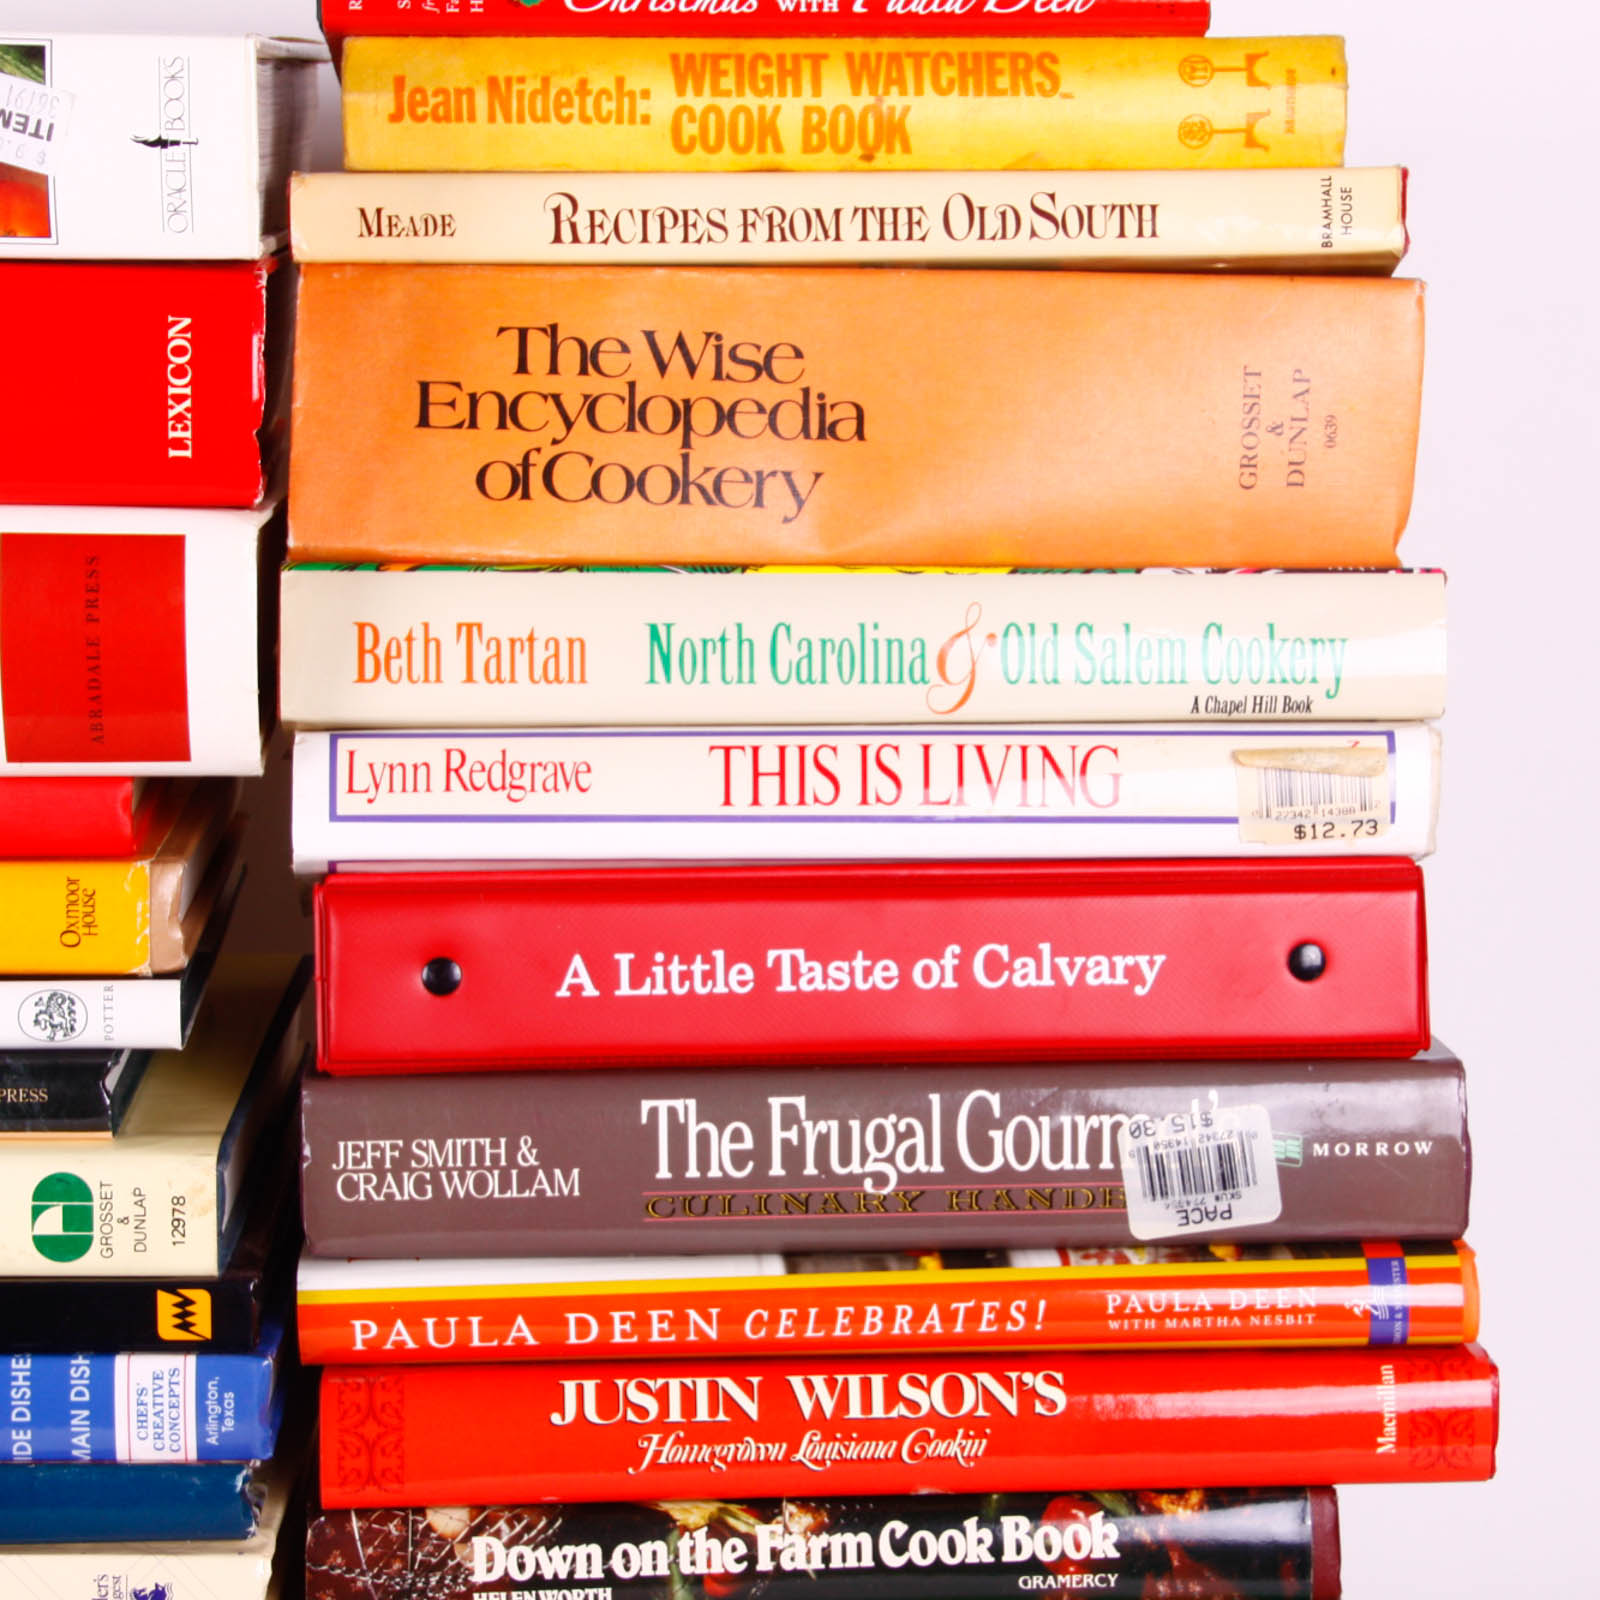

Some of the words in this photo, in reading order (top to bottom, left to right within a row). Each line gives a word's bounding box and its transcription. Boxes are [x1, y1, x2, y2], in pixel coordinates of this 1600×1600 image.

[164, 56, 186, 132] BOOKS
[387, 75, 475, 124] Jean
[487, 75, 652, 126] Nidetch:
[670, 52, 831, 98] WEIGHT
[845, 51, 1062, 98] WATCHERS
[671, 104, 785, 155] COOK
[800, 104, 912, 156] BOOK
[166, 152, 190, 234] ORACLE
[357, 207, 457, 239] MEADE
[543, 192, 728, 246] RECIPES
[738, 205, 842, 243] FROM
[851, 205, 931, 243] THE
[942, 192, 1022, 242] OLD
[1029, 191, 1161, 241] SOUTH
[1321, 174, 1334, 249] BRAMHALL
[1341, 186, 1353, 237] HOUSE
[497, 323, 632, 378] The
[641, 330, 806, 384] Wise
[167, 315, 193, 459] LEXICON
[415, 380, 867, 450] Encyclopedia
[1238, 365, 1262, 491] GROSSET
[1266, 421, 1284, 437] &
[1286, 369, 1311, 487] DUNLAP
[1324, 415, 1338, 449] 0639
[476, 447, 541, 501] of
[542, 450, 824, 524] Cookery
[85, 555, 100, 623] PRESS
[353, 621, 443, 685] Beth
[457, 621, 588, 685] Tartan
[644, 621, 757, 686] North
[769, 621, 930, 686] Carolina
[926, 601, 997, 716] &
[1001, 621, 1061, 686] Old
[1074, 621, 1189, 686] Salem
[1202, 621, 1348, 699] Cookery
[86, 637, 105, 745] ABRADALE
[1190, 695, 1200, 714] A
[1204, 695, 1248, 716] Chapel
[1252, 695, 1278, 714] Hill
[1282, 695, 1313, 714] Book
[346, 749, 431, 804] Lynn
[443, 748, 593, 803] Redgrave
[709, 744, 841, 807] THIS
[858, 744, 902, 807] IS
[918, 744, 1124, 809] LIVING
[1294, 818, 1378, 840] $12.73
[60, 876, 81, 948] Oxmoor
[82, 888, 98, 936] House
[555, 953, 600, 998] A
[614, 949, 755, 997] Little
[767, 948, 899, 993] Taste
[912, 944, 961, 989] of
[973, 943, 1167, 996] Calvary
[103, 984, 115, 1041] POTTER
[331, 1140, 403, 1171] JEFF
[411, 1137, 507, 1169] SMITH
[517, 1135, 540, 1167] &
[641, 1098, 754, 1180] The
[768, 1092, 945, 1195] Frugal
[1129, 1111, 1214, 1140] $15.30
[1312, 1141, 1433, 1157] MORROW
[336, 1172, 432, 1202] CRAIG
[442, 1168, 581, 1200] WOLLAM
[645, 1190, 925, 1219] CULINARY
[100, 1181, 113, 1259] GROSSET
[118, 1216, 129, 1225] &
[133, 1187, 147, 1253] DUNLAP
[171, 1195, 186, 1246] 12978
[1176, 1203, 1233, 1227] PACE
[350, 1313, 540, 1350] PAULA
[564, 1307, 721, 1344] DEEN
[744, 1299, 1047, 1339] CELEBRATES!
[1106, 1289, 1214, 1315] PAULA
[1229, 1287, 1317, 1311] DEEN
[1108, 1318, 1156, 1331] WITH
[1165, 1316, 1242, 1330] MARTHA
[1250, 1313, 1317, 1327] NESBIT
[152, 1369, 164, 1452] CREATIVE
[168, 1368, 181, 1453] CONCEPTS
[205, 1377, 220, 1446] Arlington,
[221, 1391, 235, 1433] Texas
[549, 1376, 763, 1426] JUSTIN
[785, 1370, 1068, 1421] WILSON'S
[1376, 1365, 1397, 1454] Macmillan
[628, 1432, 788, 1475] Homegrown
[791, 1429, 898, 1470] Louisiana
[469, 1536, 604, 1584] Down
[611, 1539, 671, 1579] on
[677, 1527, 748, 1575] the
[755, 1523, 875, 1572] Farm
[879, 1516, 995, 1568] Cook
[1001, 1512, 1120, 1563] Book
[1018, 1573, 1119, 1590] GRAMERCY
